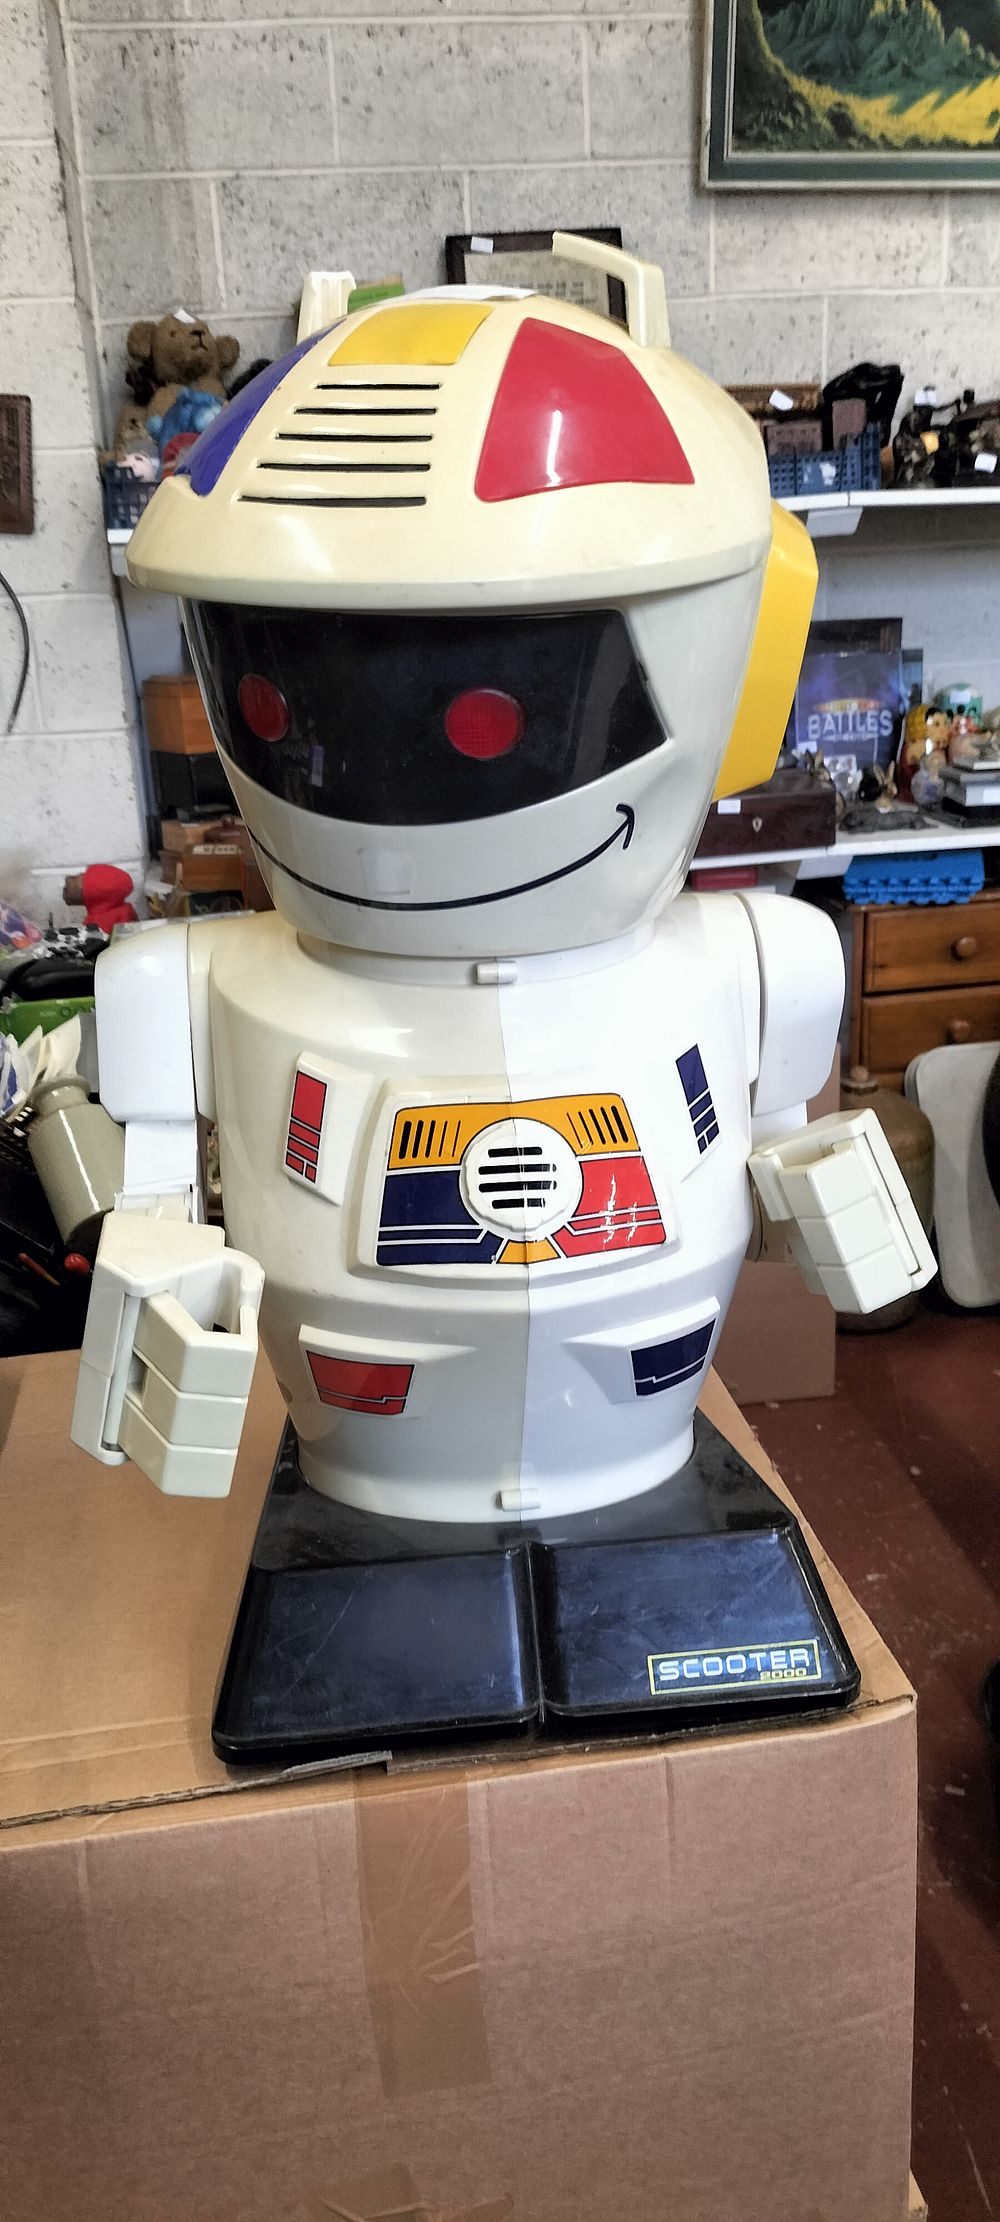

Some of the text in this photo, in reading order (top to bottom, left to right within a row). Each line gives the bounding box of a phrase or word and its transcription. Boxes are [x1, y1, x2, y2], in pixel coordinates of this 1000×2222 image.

[807, 710, 893, 740] BATTLES
[659, 1648, 809, 1681] SCOOTER
[760, 1667, 807, 1681] 2000
